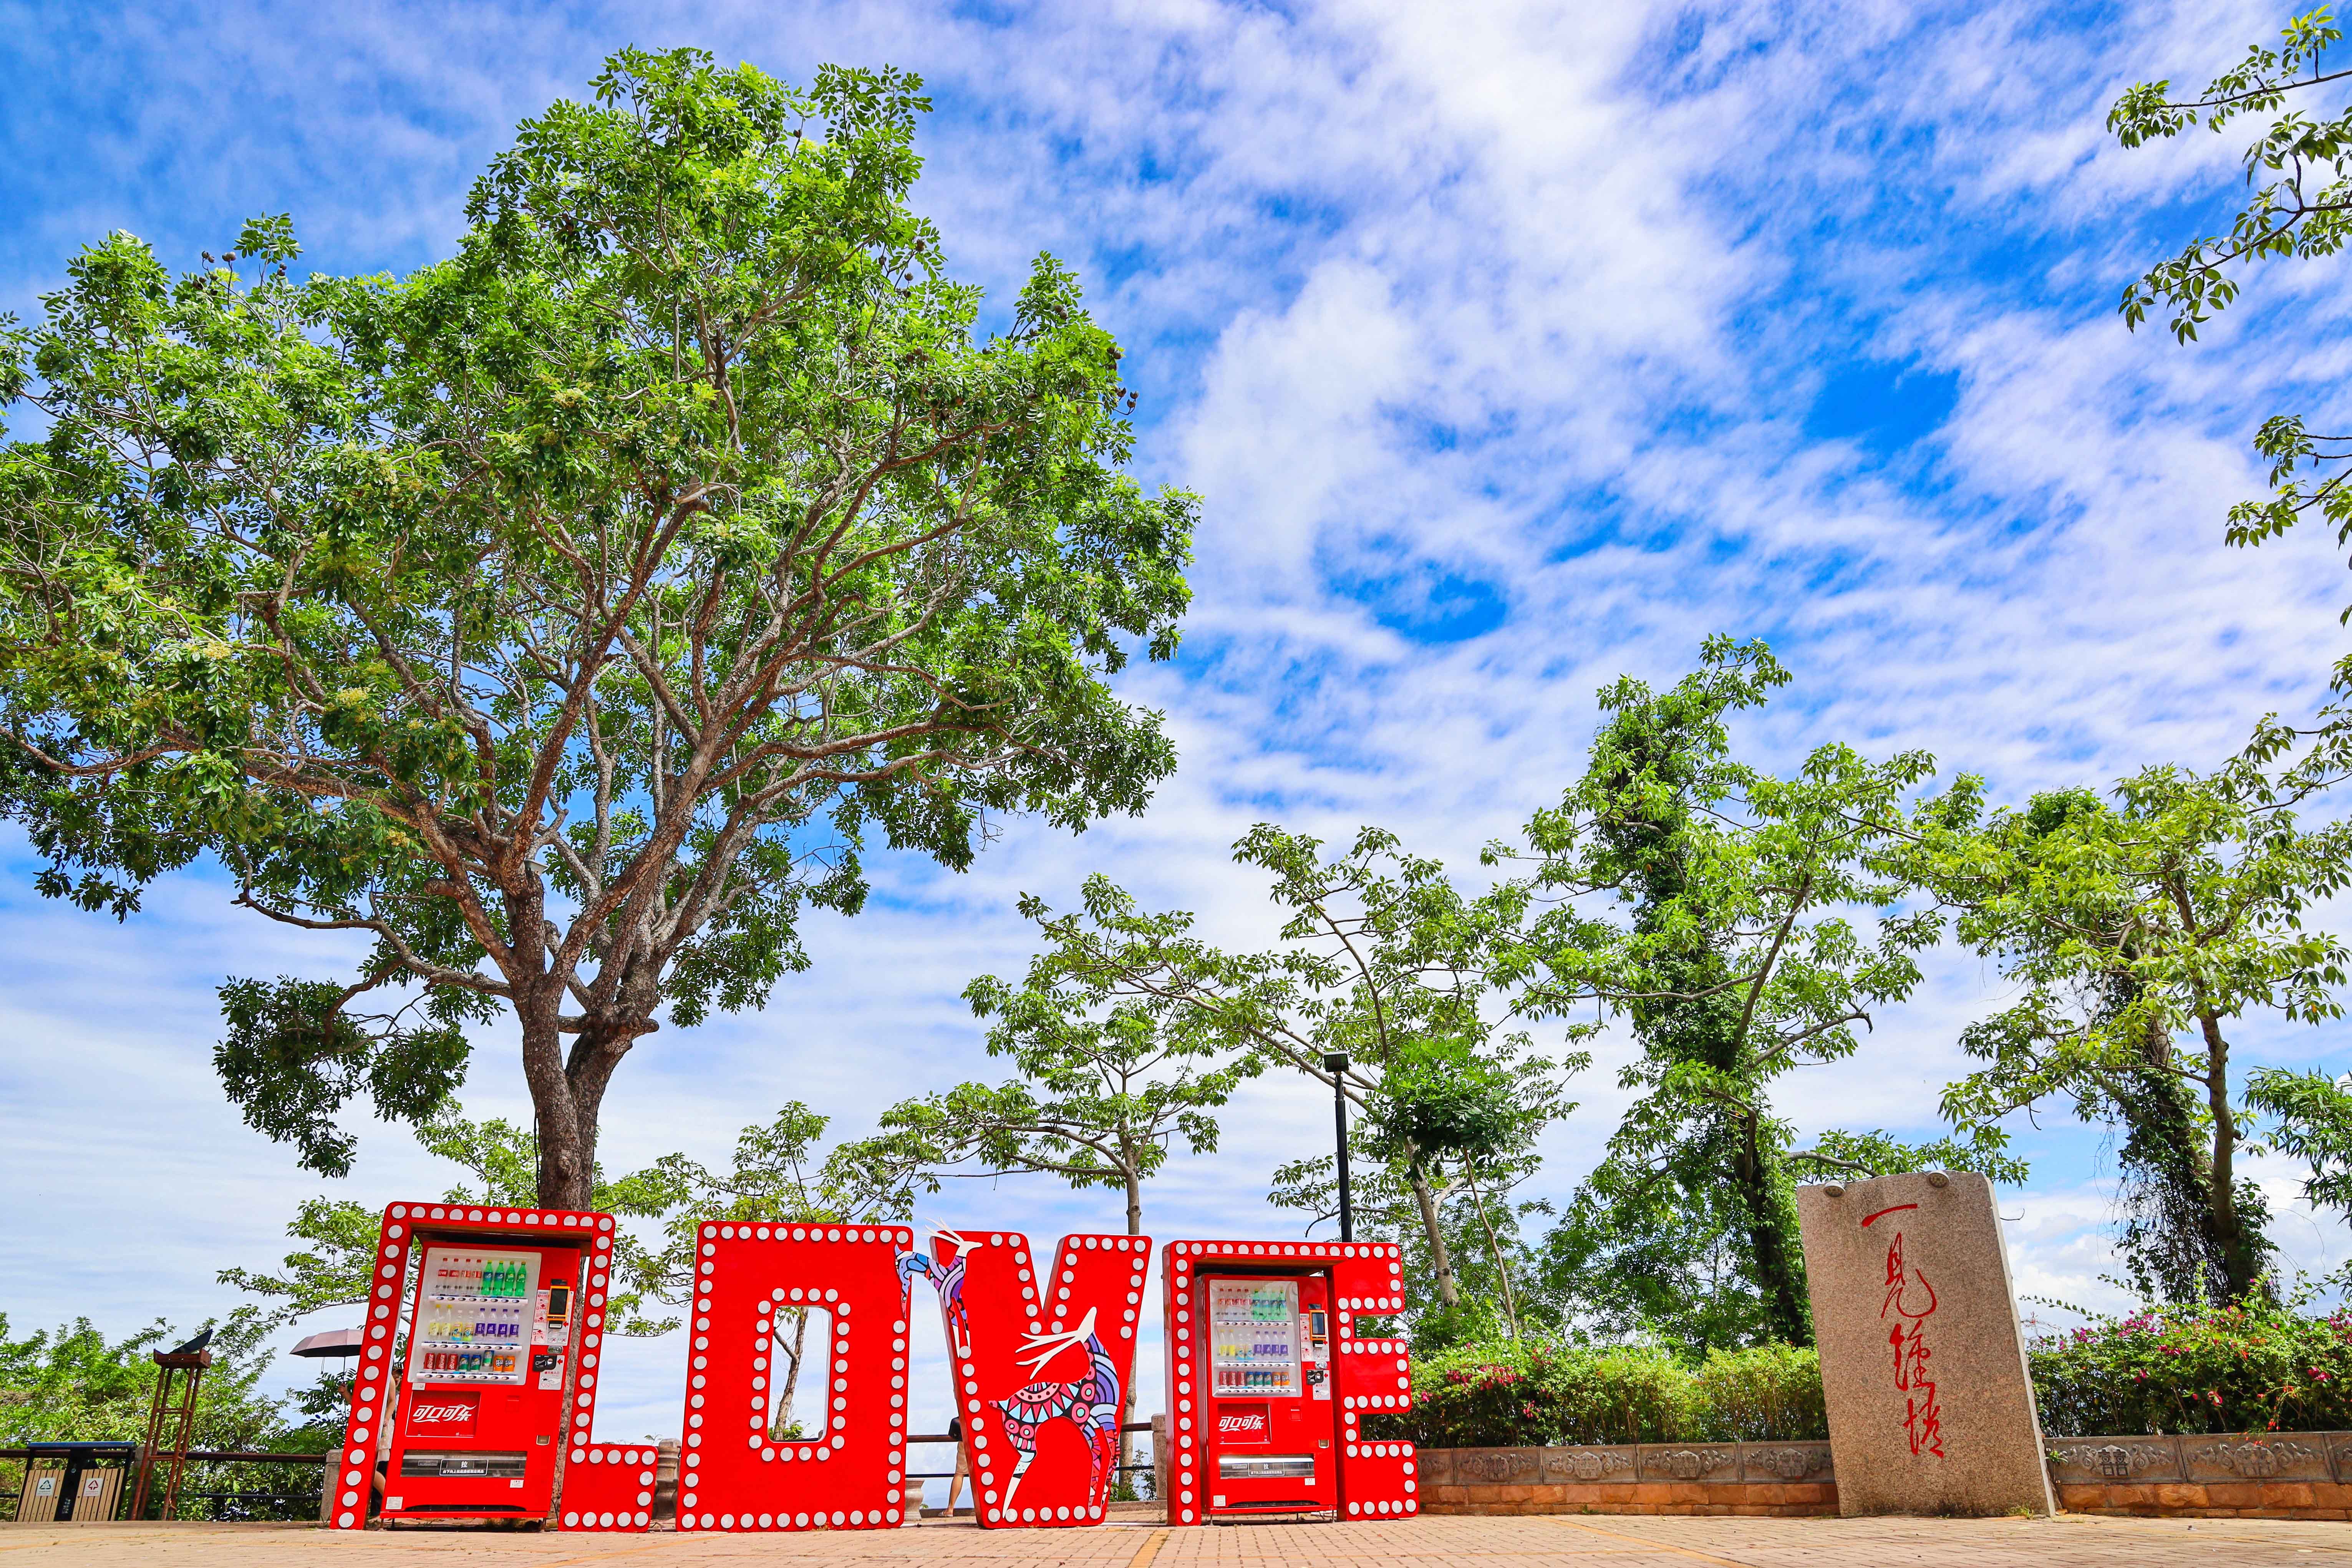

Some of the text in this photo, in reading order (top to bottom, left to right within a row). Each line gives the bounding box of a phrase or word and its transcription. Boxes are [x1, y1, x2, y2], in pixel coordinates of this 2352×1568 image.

[412, 1404, 477, 1423] 可口可乐
[1218, 1414, 1266, 1432] 可口可乐
